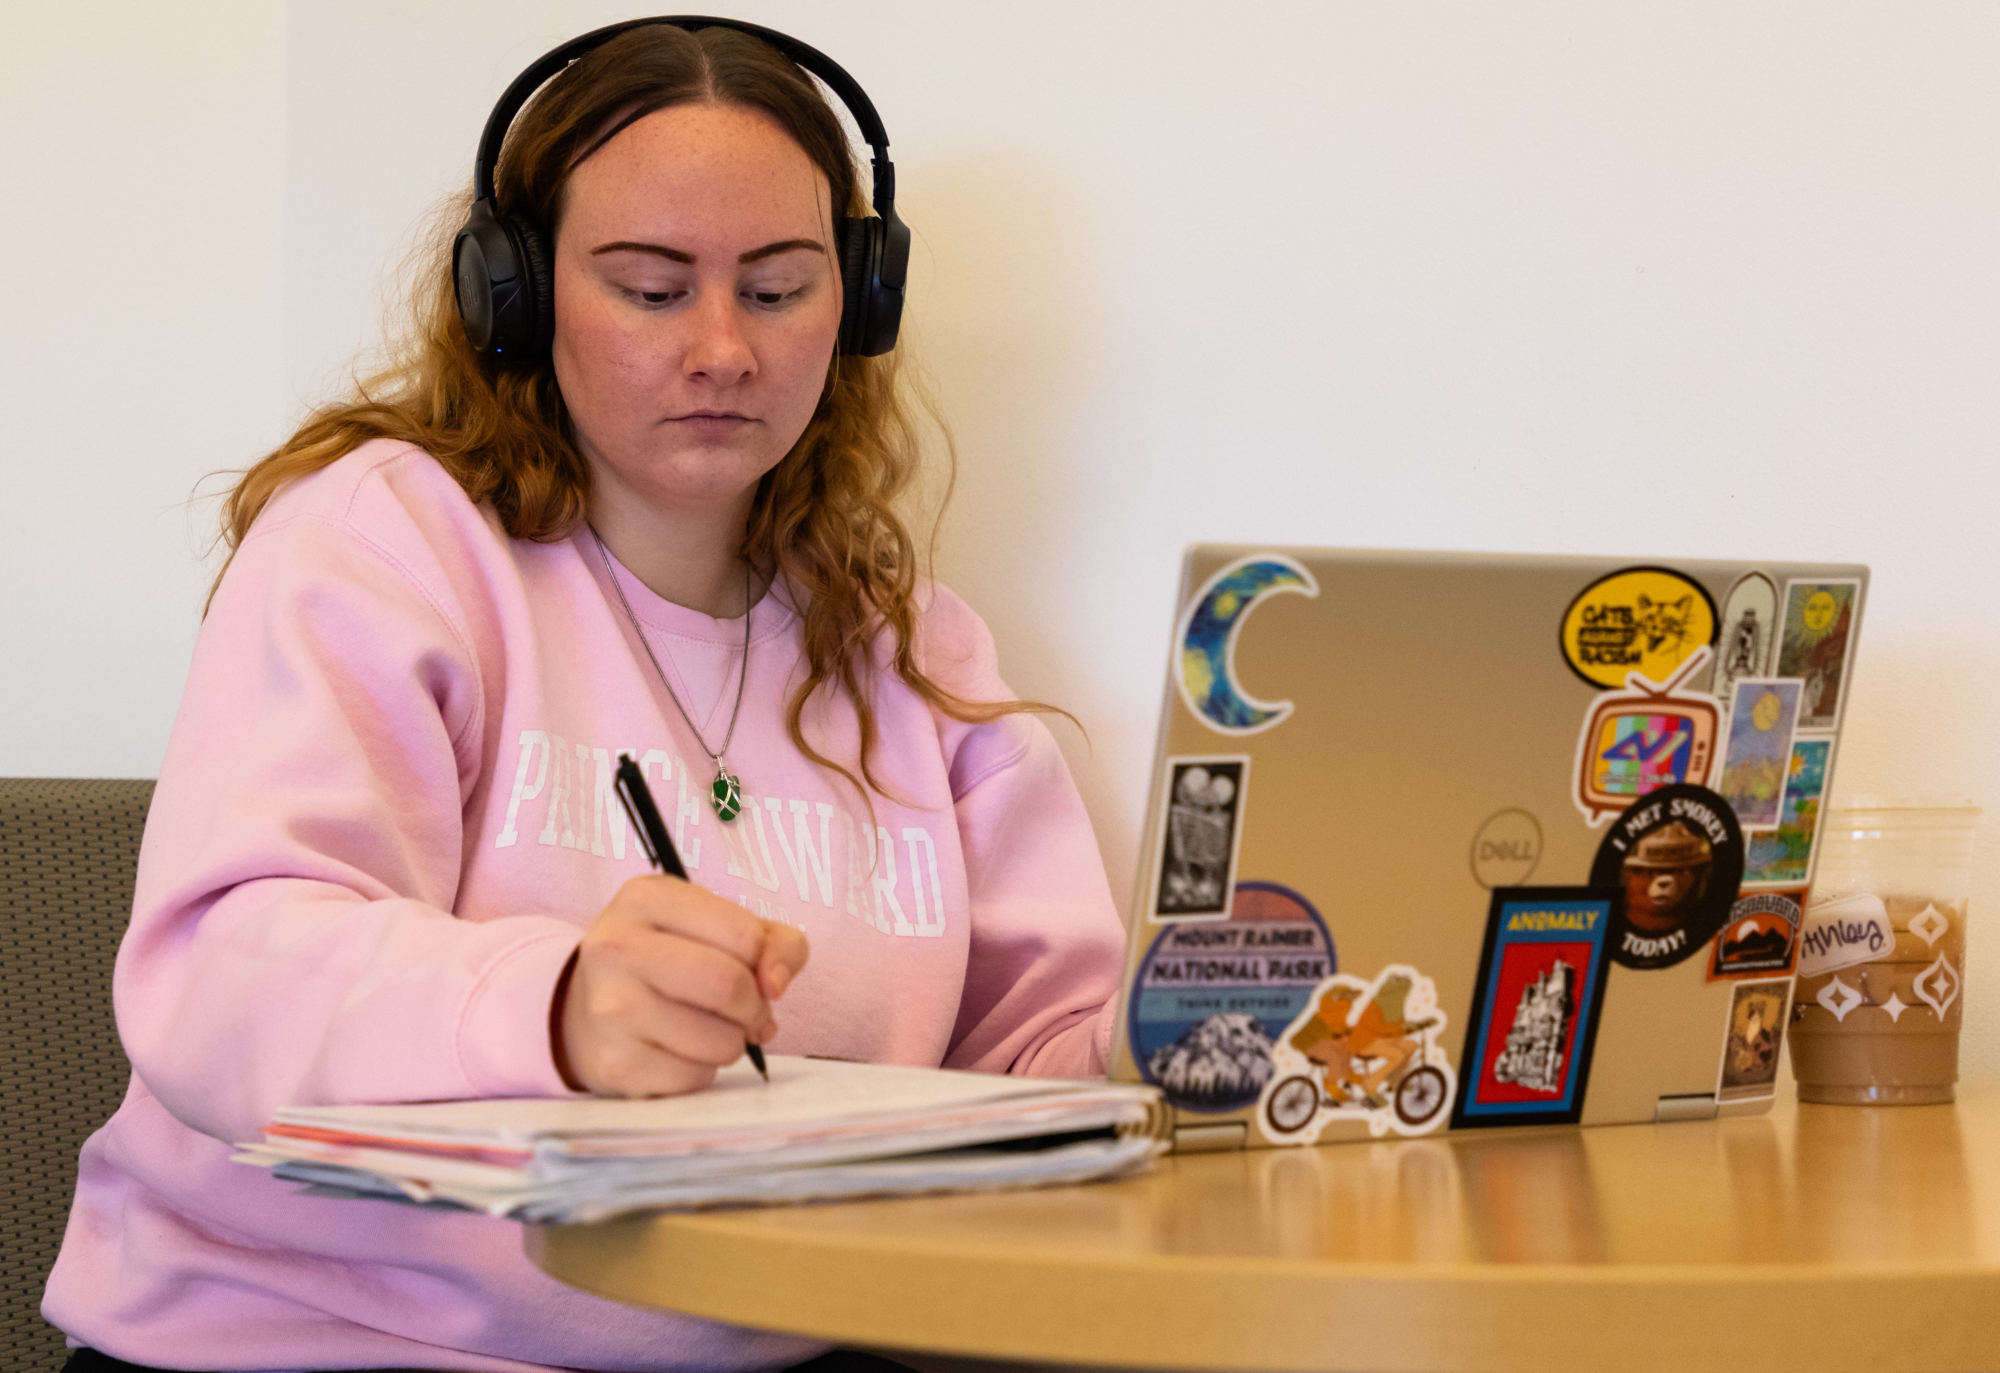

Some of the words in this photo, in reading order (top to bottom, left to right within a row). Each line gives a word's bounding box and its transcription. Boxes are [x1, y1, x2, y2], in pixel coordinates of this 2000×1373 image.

[1612, 838, 1627, 851] I
[1625, 802, 1663, 838] MET
[1669, 798, 1728, 845] SMOKEY
[701, 787, 946, 938] DWARD
[1479, 839, 1533, 862] DELL
[1506, 910, 1600, 931] ANOMALY
[1727, 893, 1800, 929] ISHAWAKA
[1172, 929, 1238, 947] MOUNT
[1243, 929, 1315, 947] RAINIER
[1621, 929, 1687, 957] TODAY!
[1152, 960, 1261, 981] NATIONAL
[1267, 960, 1326, 980] PARK
